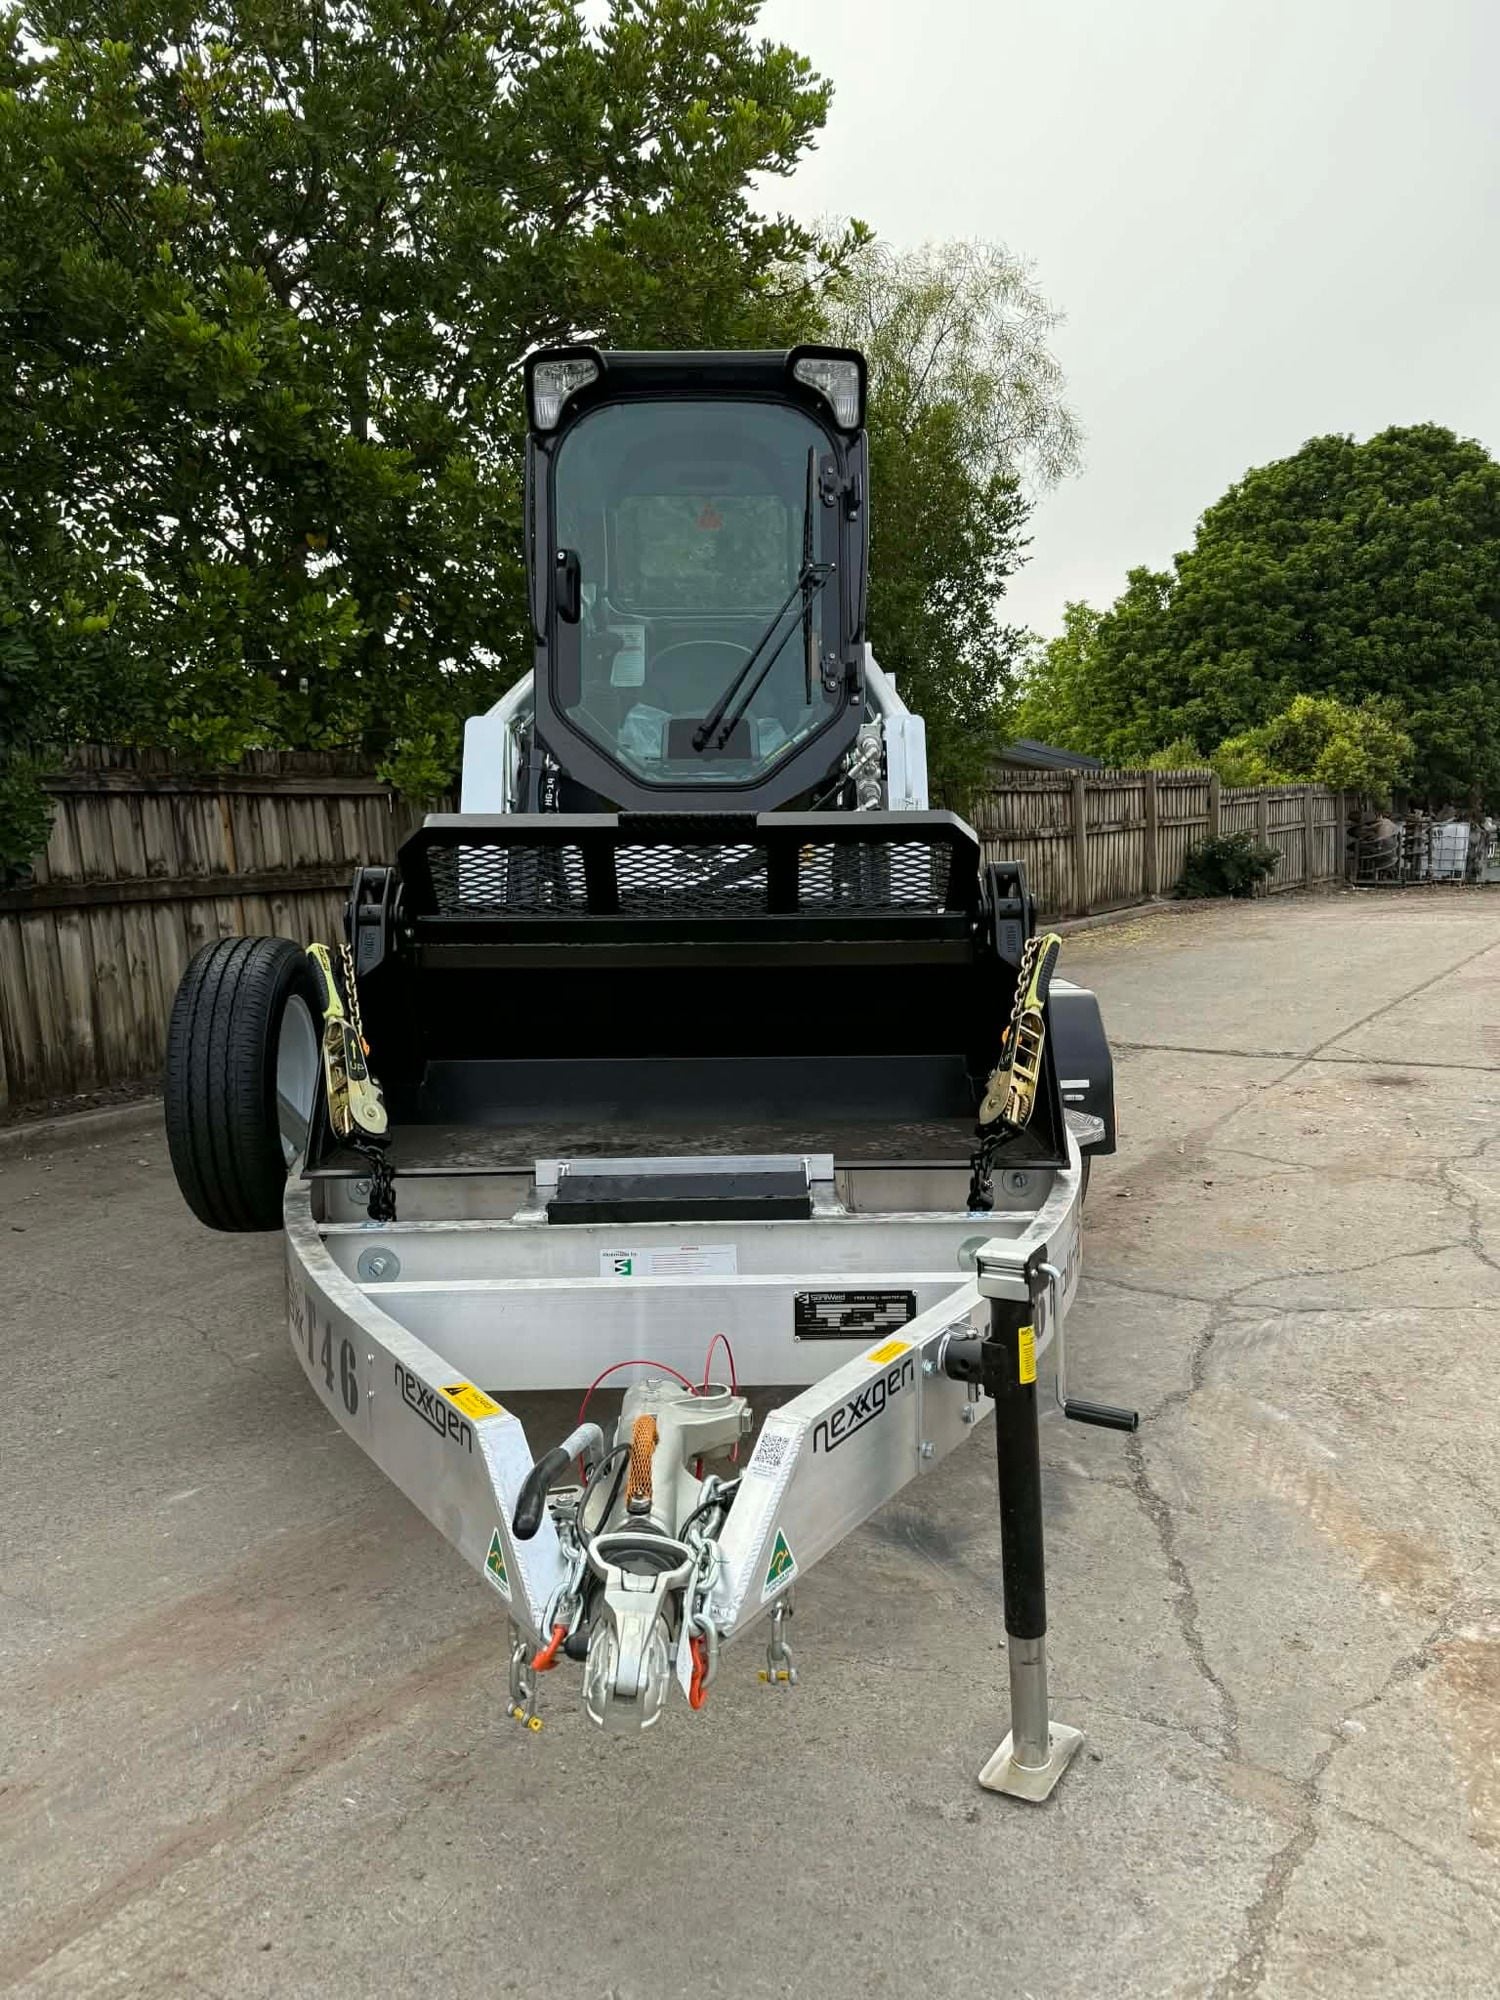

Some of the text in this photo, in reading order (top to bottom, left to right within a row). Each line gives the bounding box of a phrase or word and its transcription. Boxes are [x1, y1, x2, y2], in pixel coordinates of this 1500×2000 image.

[349, 1061, 365, 1072] UP
[394, 1362, 472, 1454] nexxgen
[813, 1358, 914, 1454] nexxgen
